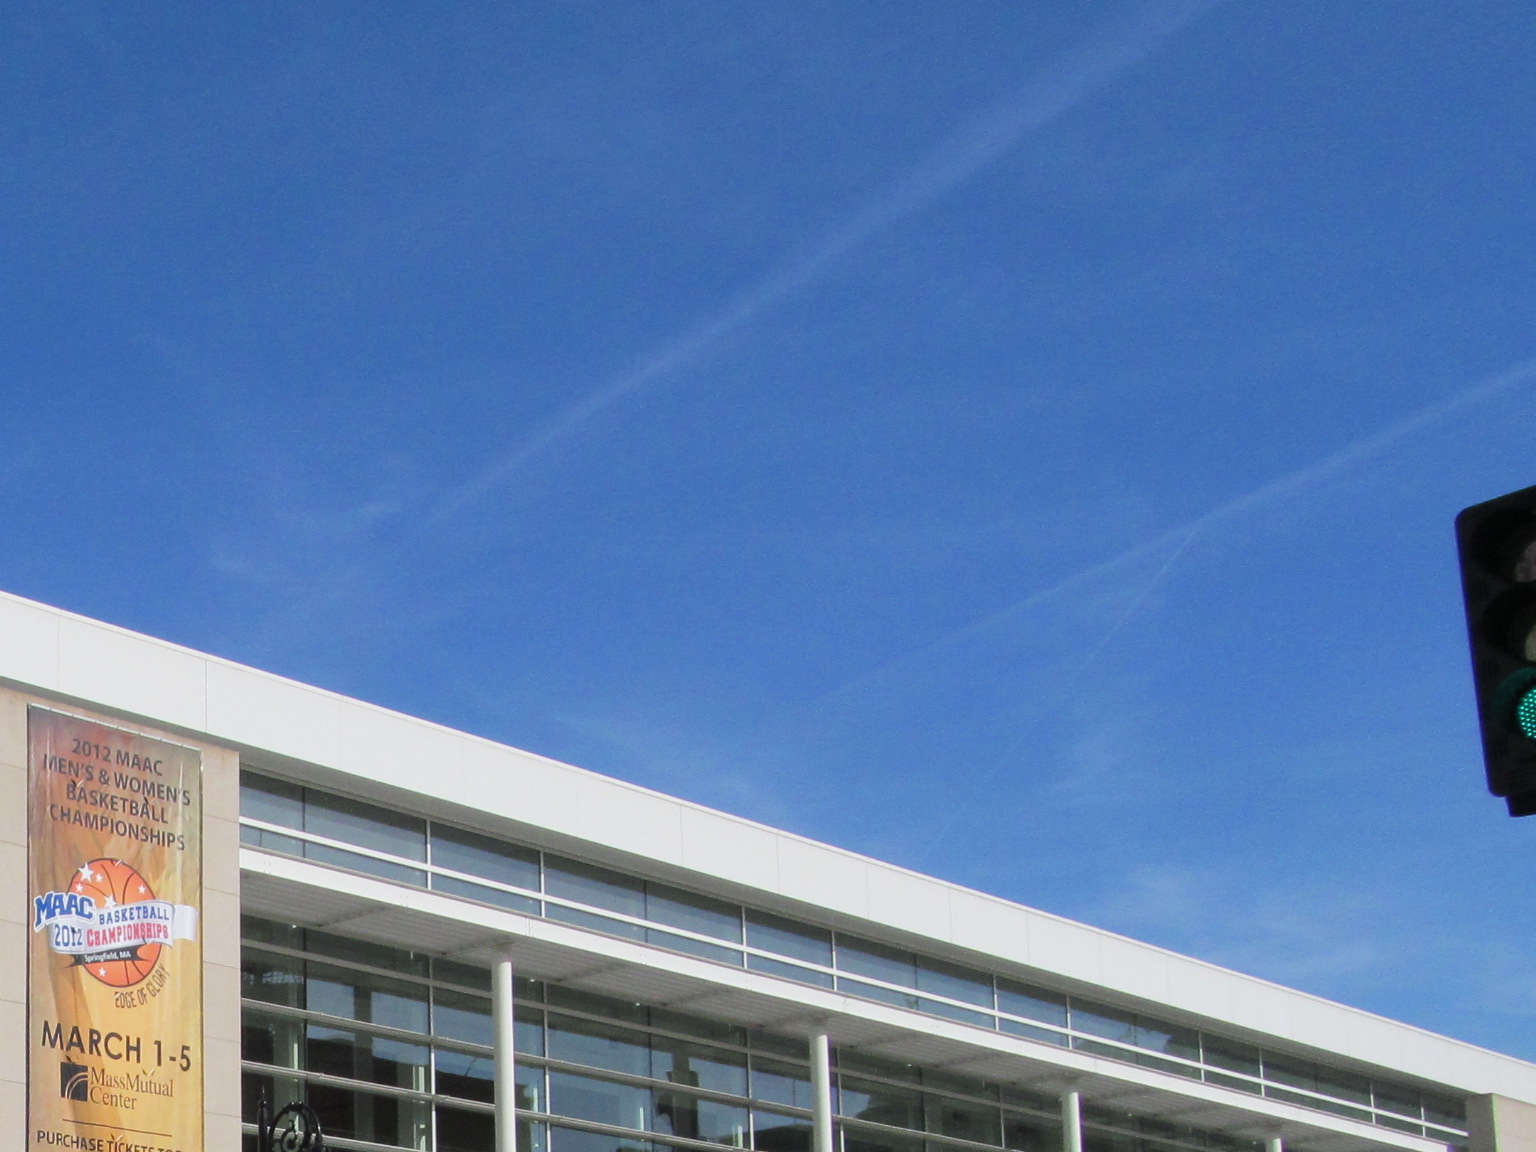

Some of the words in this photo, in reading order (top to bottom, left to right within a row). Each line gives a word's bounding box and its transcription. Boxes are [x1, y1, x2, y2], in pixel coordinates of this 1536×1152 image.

[71, 738, 112, 764] 2012
[116, 749, 164, 776] MAAC
[43, 753, 94, 781] MEN'S
[99, 769, 111, 786] &
[114, 772, 191, 806] WOMEN'S
[66, 783, 169, 824] BASKETBALL
[49, 803, 186, 850] CHAMPIONSHIPS
[34, 892, 95, 929] MAAC
[99, 905, 170, 926] BASKETBALL
[53, 923, 84, 947] 2012
[86, 922, 170, 947] CHAMPIONSHIPS
[84, 950, 119, 964] Springfield,
[120, 950, 132, 960] MA
[113, 991, 138, 1009] EDGE
[136, 987, 149, 1006] OF
[145, 962, 171, 998] GLORY
[41, 1019, 142, 1064] MARCH
[89, 1085, 138, 1110] Center
[90, 1066, 175, 1098] MassMutual
